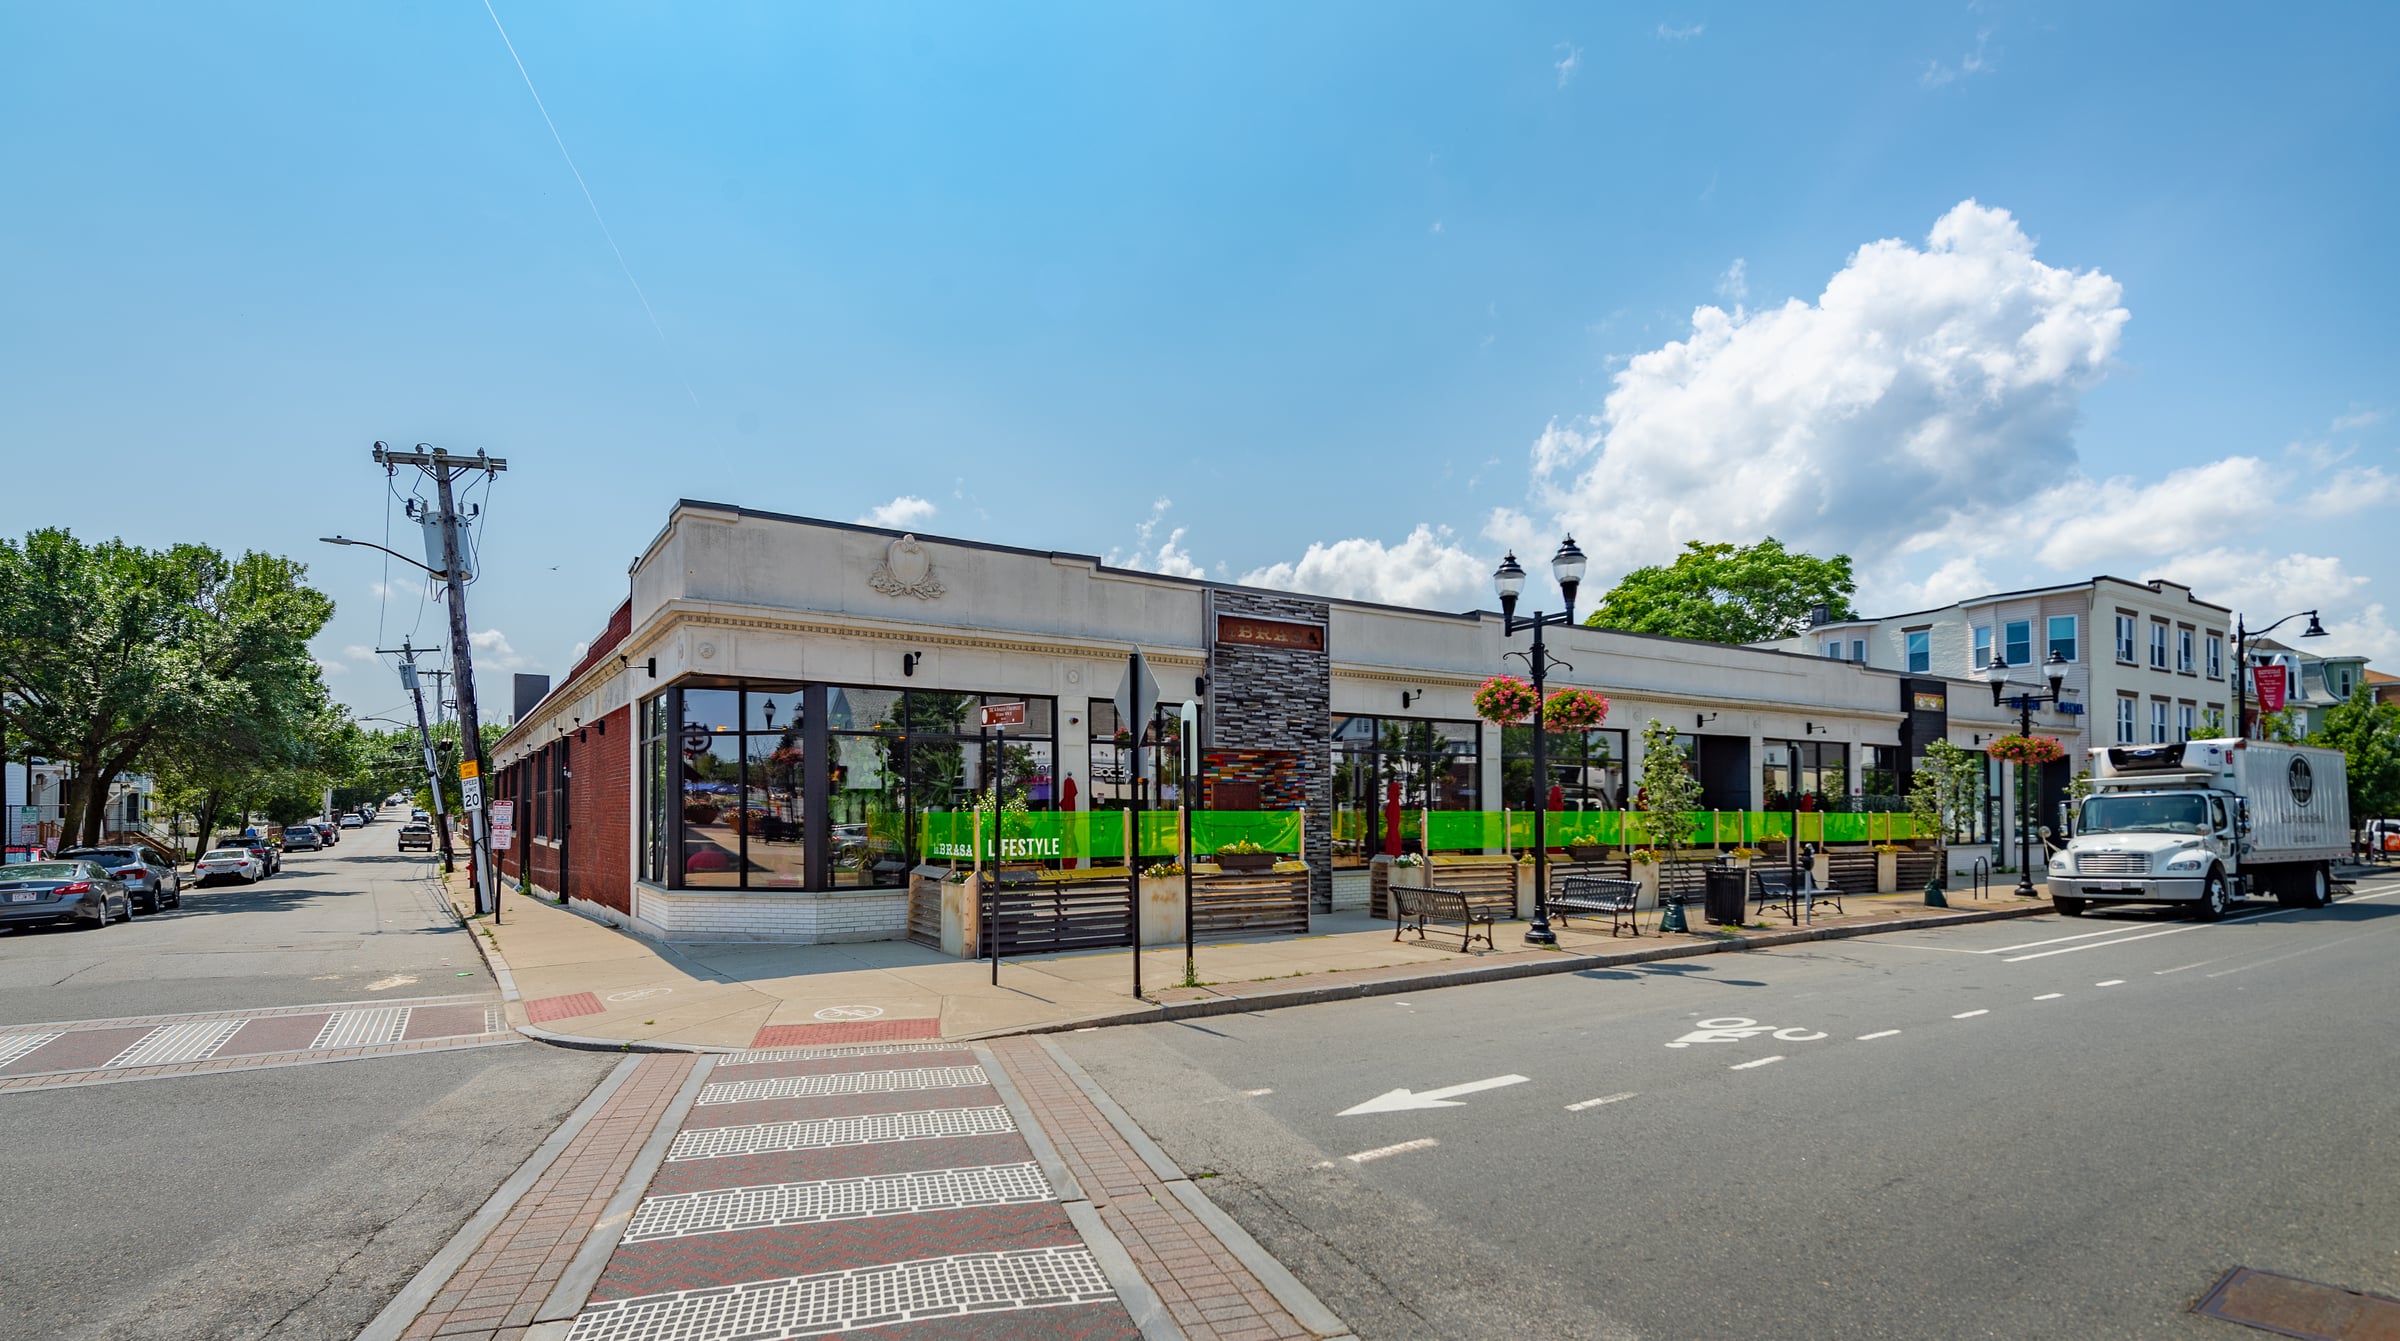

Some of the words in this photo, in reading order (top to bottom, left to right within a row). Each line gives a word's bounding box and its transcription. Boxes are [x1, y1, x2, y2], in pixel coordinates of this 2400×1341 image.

[463, 779, 477, 787] SPEED
[465, 786, 477, 794] LIMIT
[465, 793, 479, 807] 20
[988, 837, 1060, 857] LFESTYLE
